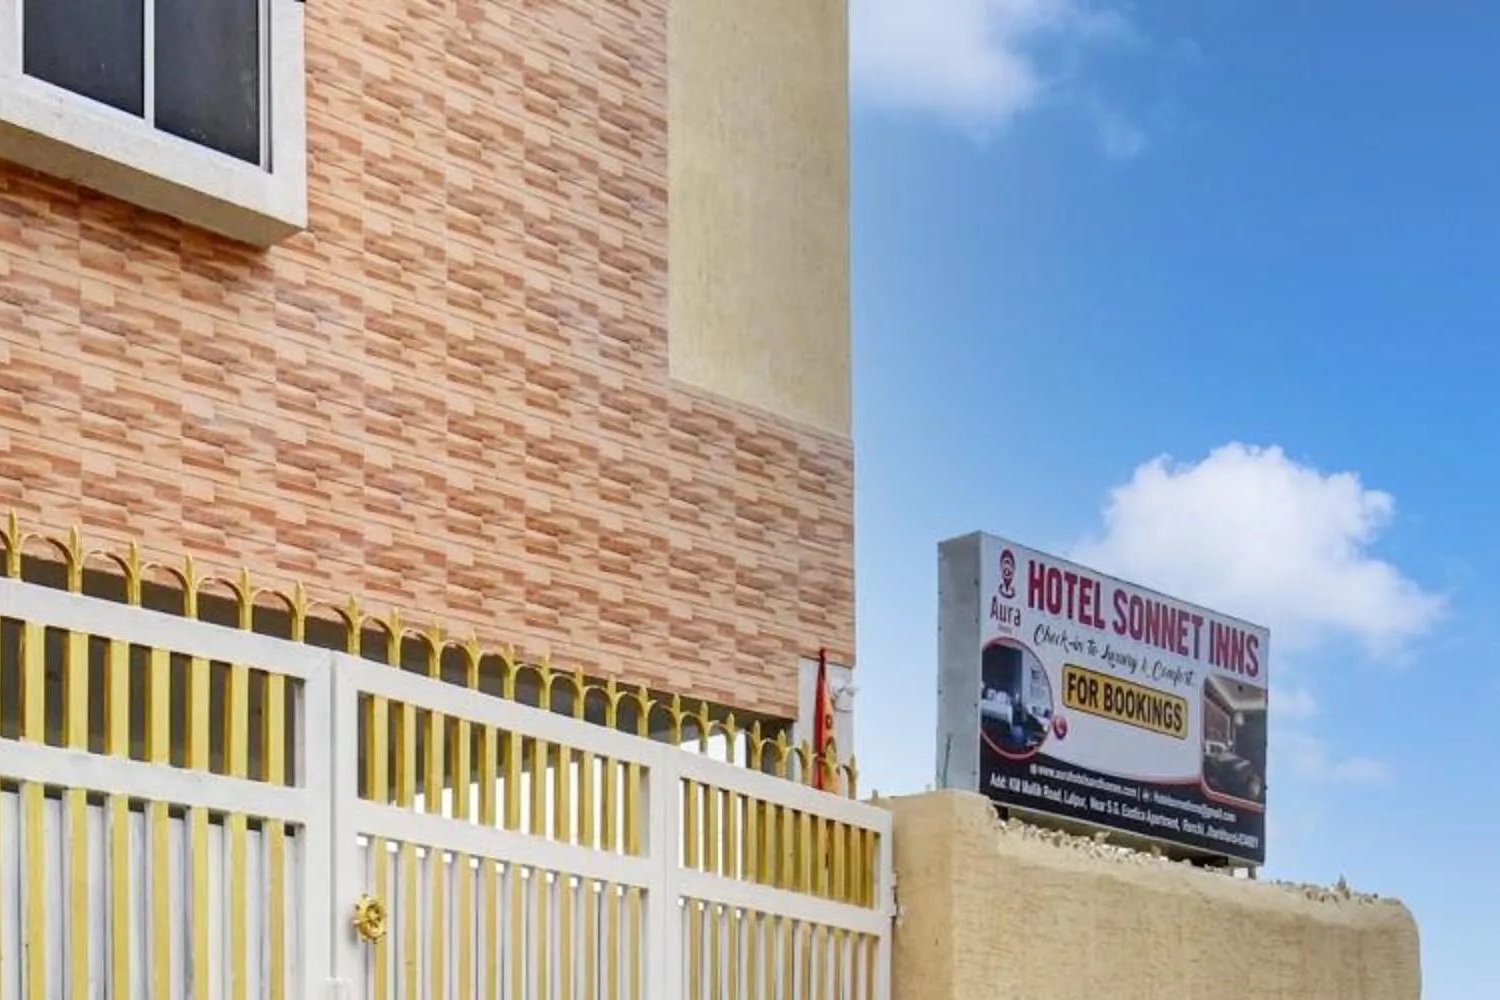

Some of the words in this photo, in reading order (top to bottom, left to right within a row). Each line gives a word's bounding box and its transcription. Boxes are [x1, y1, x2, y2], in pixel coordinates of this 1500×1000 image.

[989, 595, 1021, 627] Aura
[1027, 560, 1106, 631] HOTEL
[1112, 588, 1205, 660] SONNET
[1208, 619, 1259, 678] INNS
[1067, 671, 1100, 710] FOR
[1103, 683, 1184, 733] BOOKINGS
